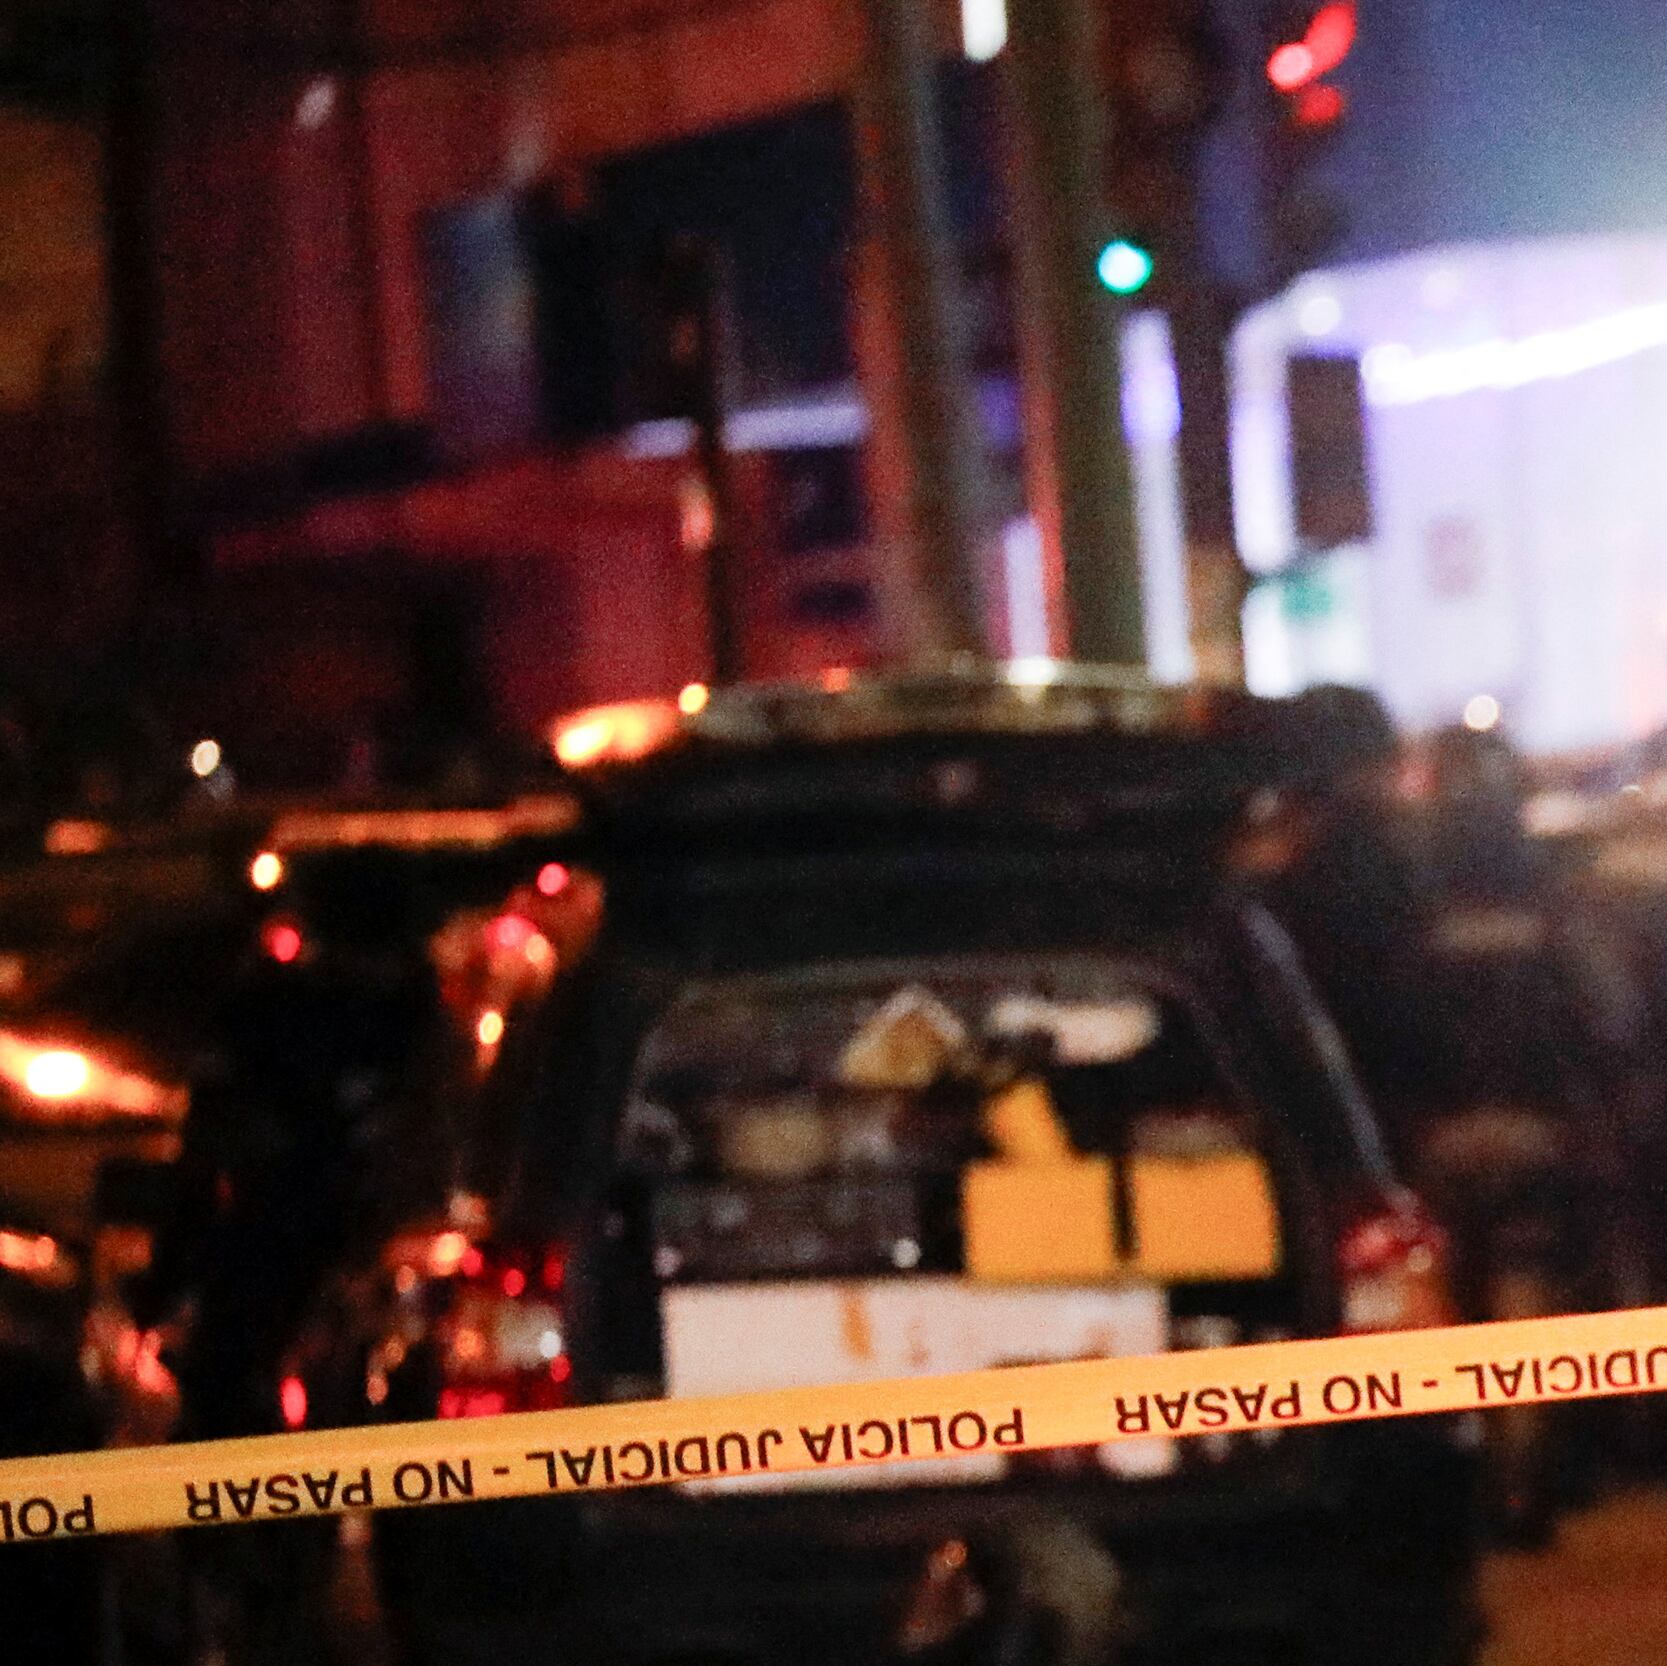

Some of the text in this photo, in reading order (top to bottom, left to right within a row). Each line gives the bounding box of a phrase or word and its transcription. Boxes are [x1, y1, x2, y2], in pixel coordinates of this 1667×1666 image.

[1116, 1382, 1301, 1433] PASAR
[1323, 1373, 1401, 1414] NO
[525, 1429, 783, 1490] JUDICIAL
[799, 1408, 1024, 1464] POLICIA
[184, 1467, 375, 1519] PASAR
[392, 1458, 475, 1502] NO
